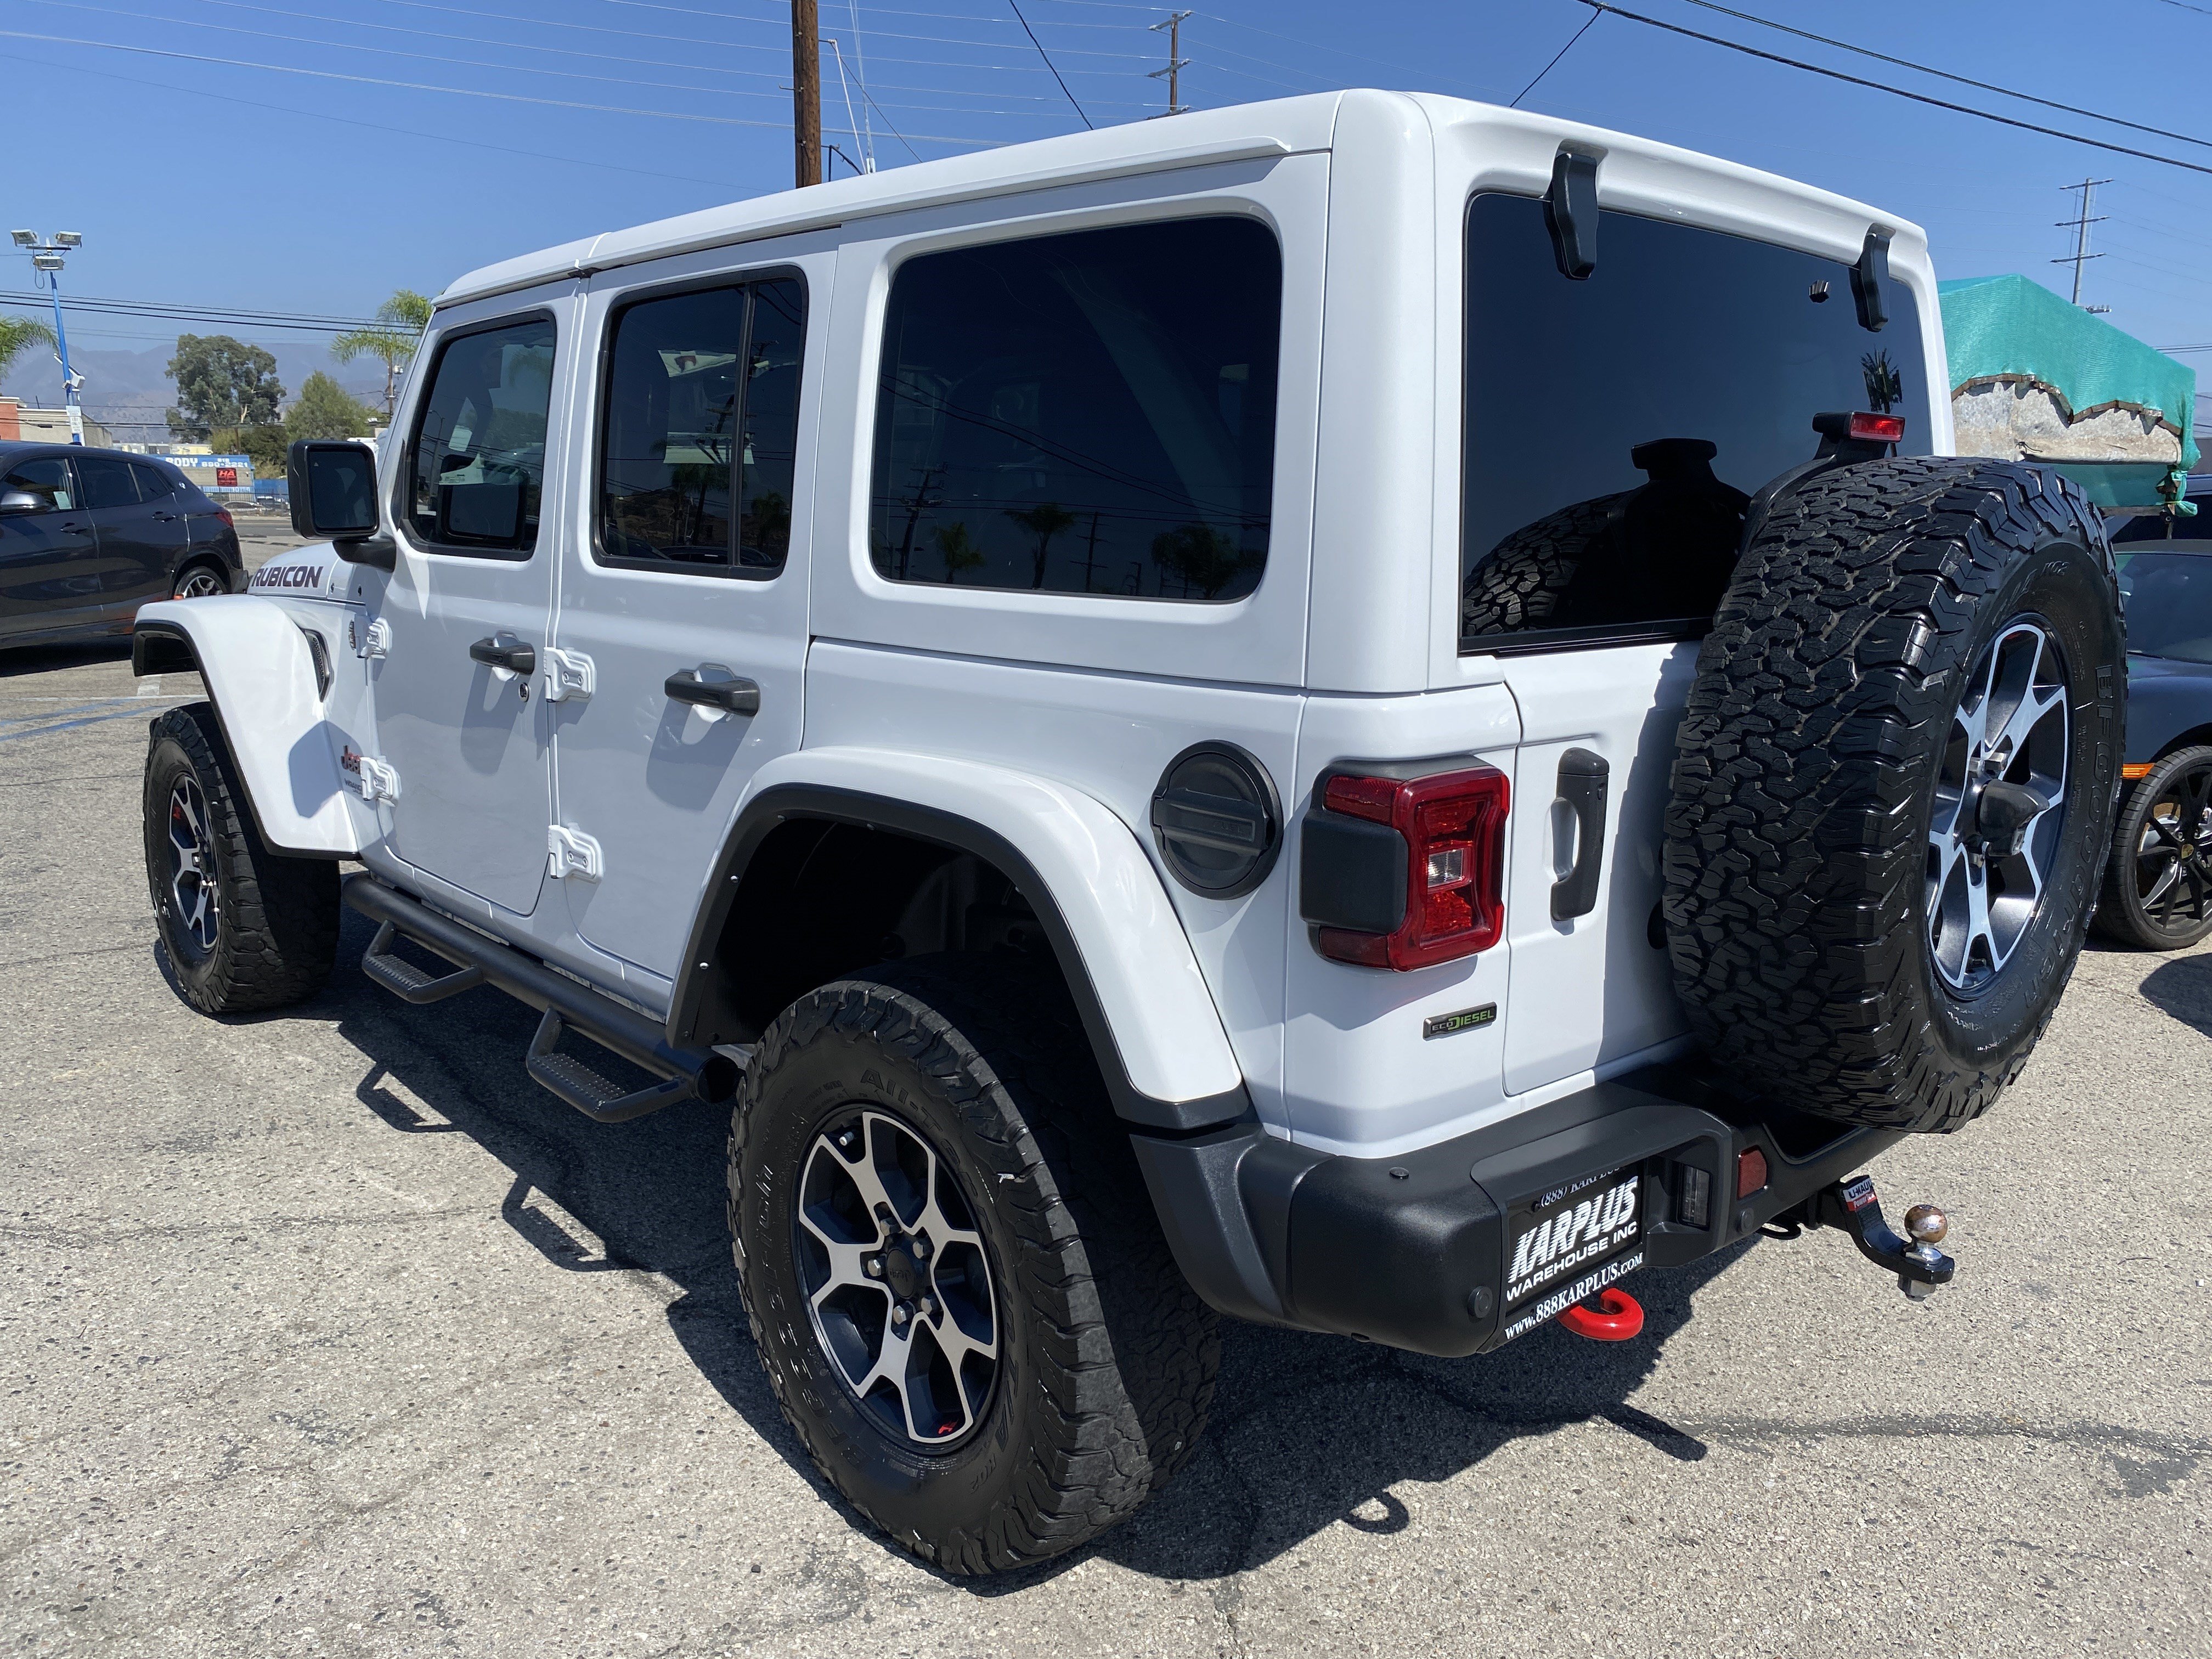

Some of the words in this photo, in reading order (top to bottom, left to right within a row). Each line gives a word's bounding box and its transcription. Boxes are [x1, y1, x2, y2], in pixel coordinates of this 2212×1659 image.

[251, 566, 324, 588] RUBICON
[1541, 1186, 1567, 1207] (888)
[1508, 1176, 1638, 1283] KARPLUS
[1506, 1237, 1609, 1301] WAREHOUSE
[1613, 1221, 1638, 1244] INC
